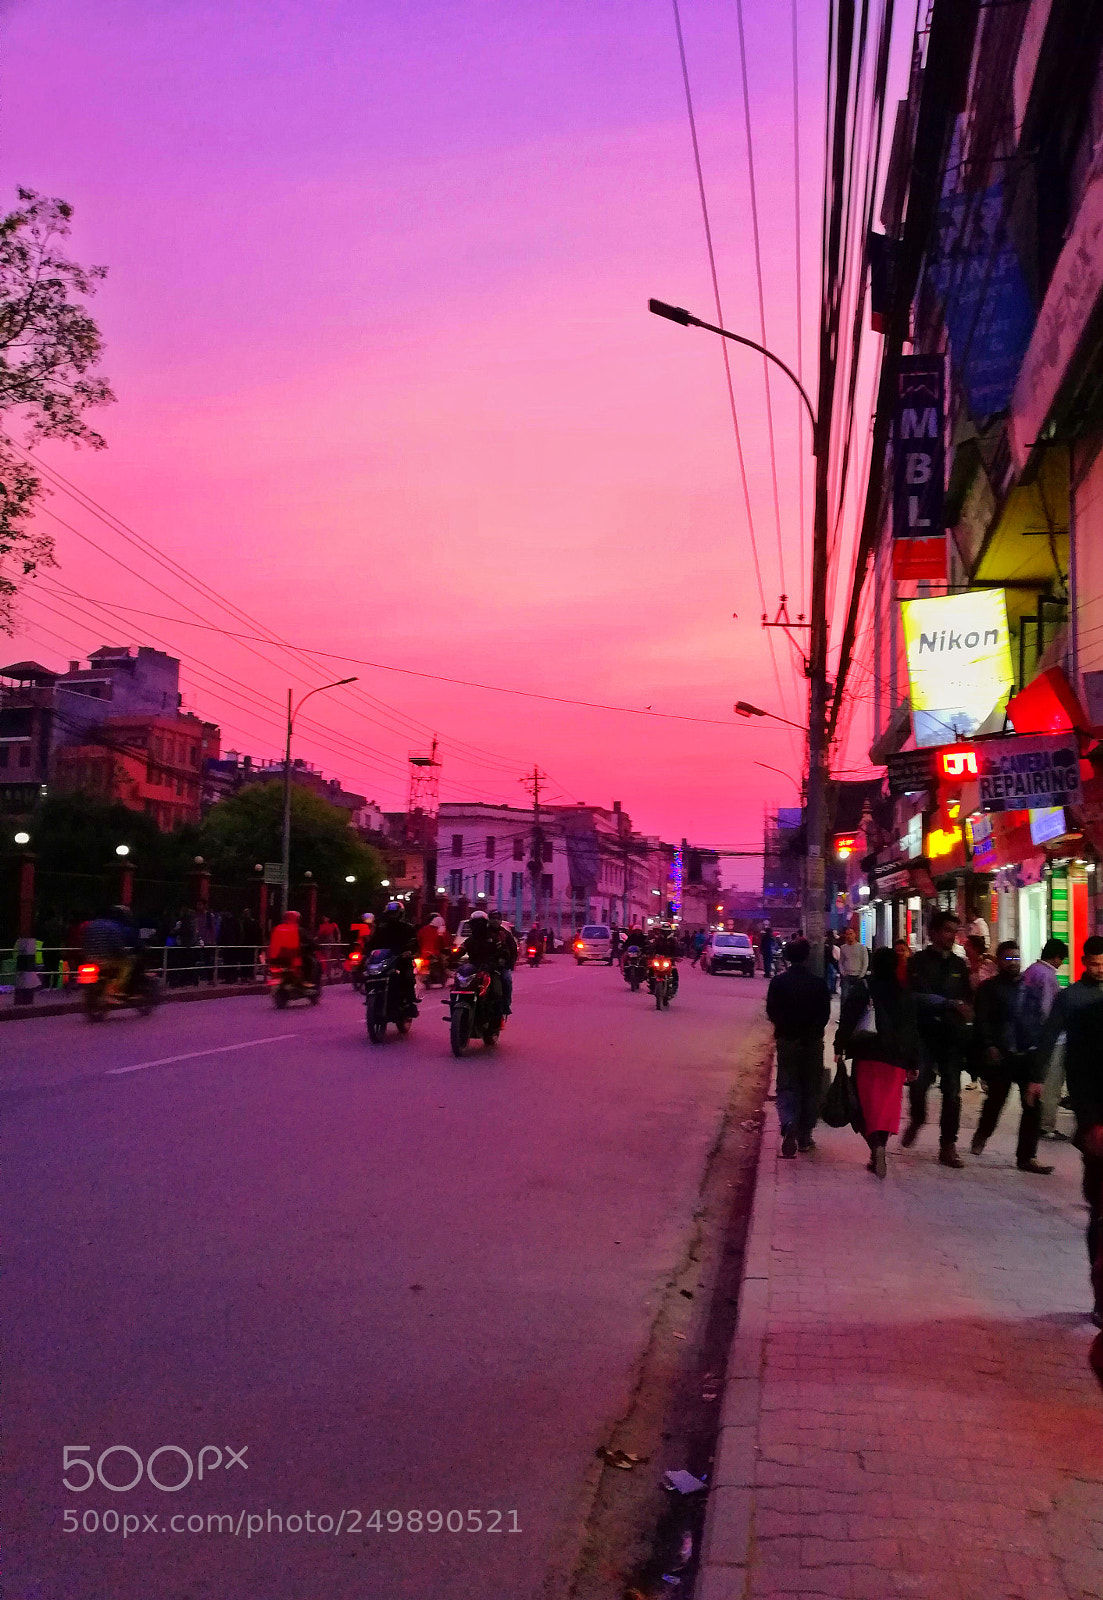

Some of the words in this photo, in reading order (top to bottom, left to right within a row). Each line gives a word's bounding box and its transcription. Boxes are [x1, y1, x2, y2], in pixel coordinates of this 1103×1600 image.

[919, 628, 999, 654] Nikon
[1000, 751, 1050, 775] CAMERA
[980, 768, 1078, 799] REPAIRING
[873, 861, 902, 874] SONY
